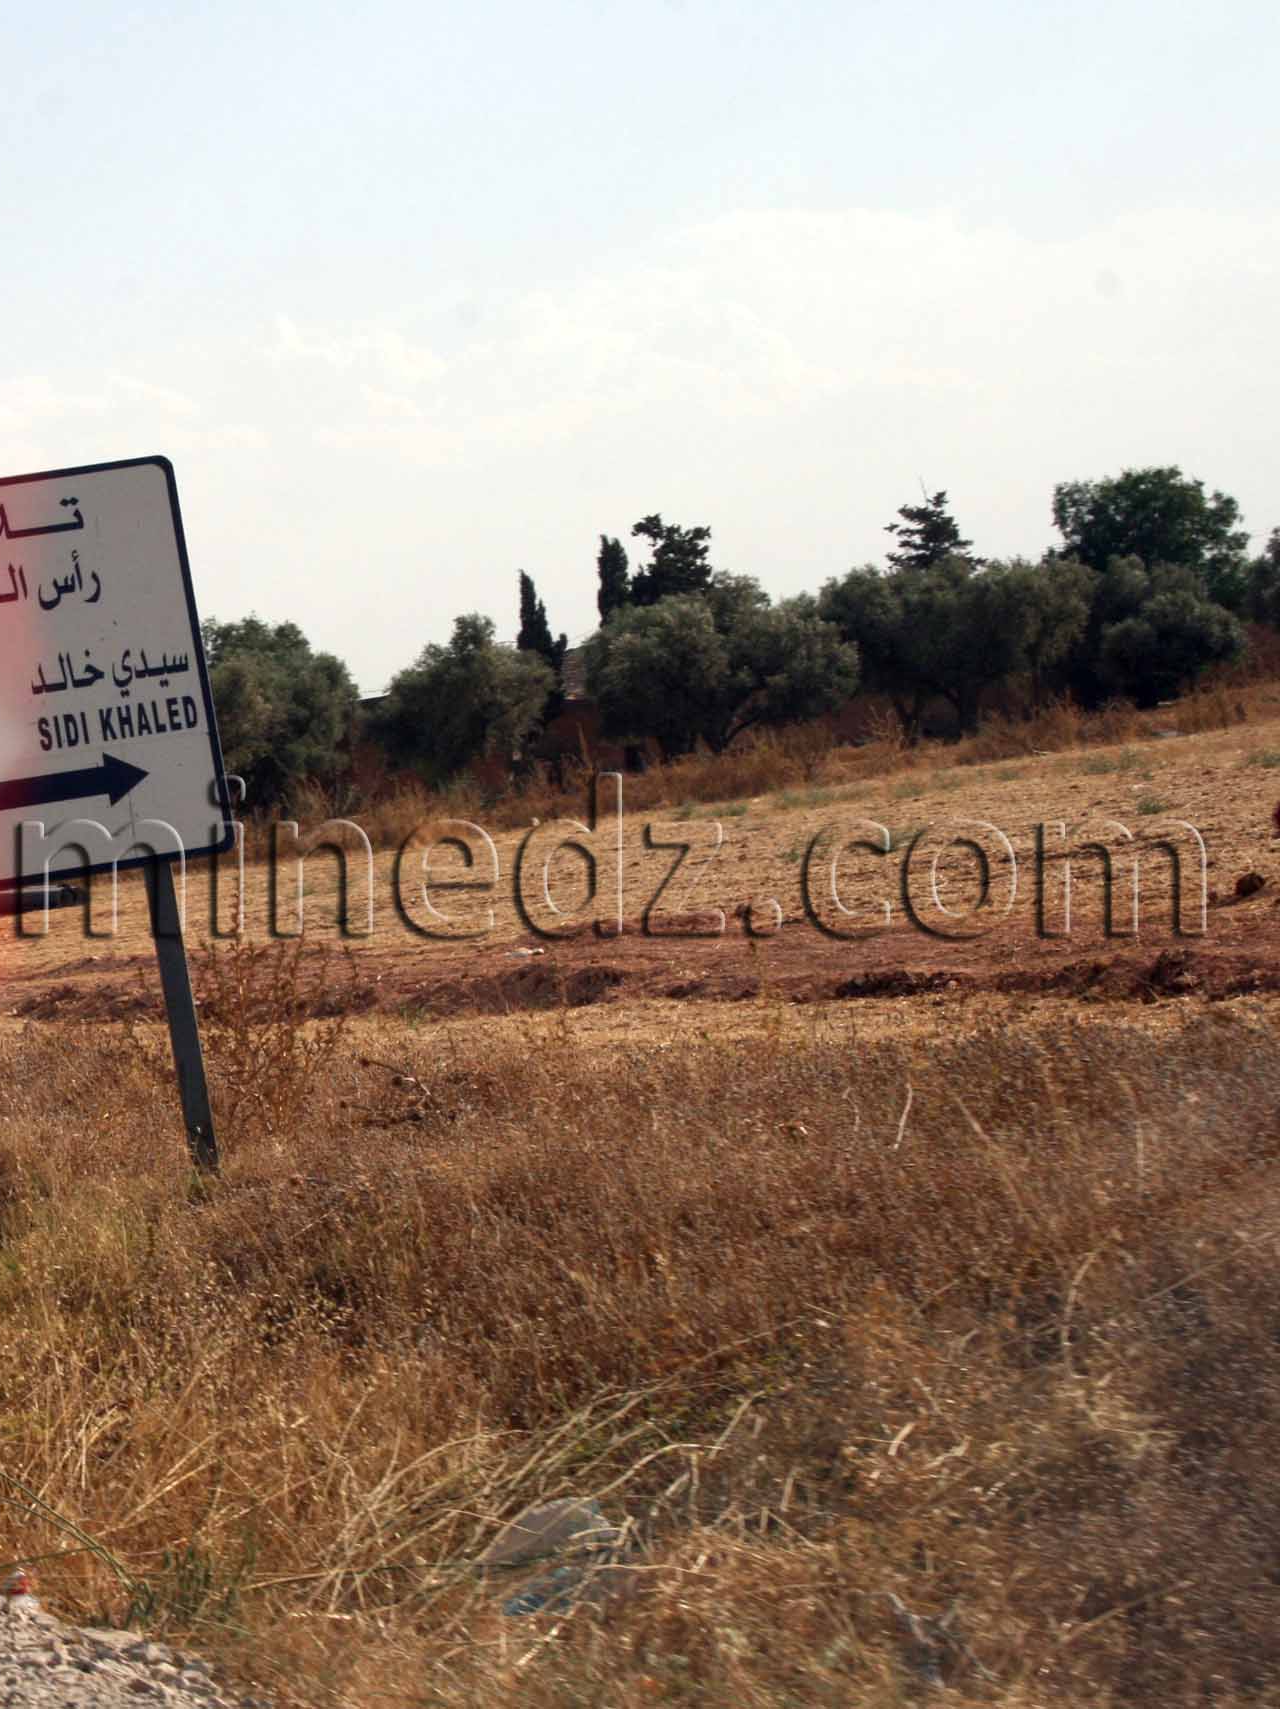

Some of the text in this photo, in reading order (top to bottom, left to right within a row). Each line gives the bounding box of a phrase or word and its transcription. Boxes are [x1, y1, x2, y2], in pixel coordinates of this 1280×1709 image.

[37, 550, 101, 610] رأس
[111, 649, 189, 696] سيدي
[37, 695, 199, 752] SIDI KHALED
